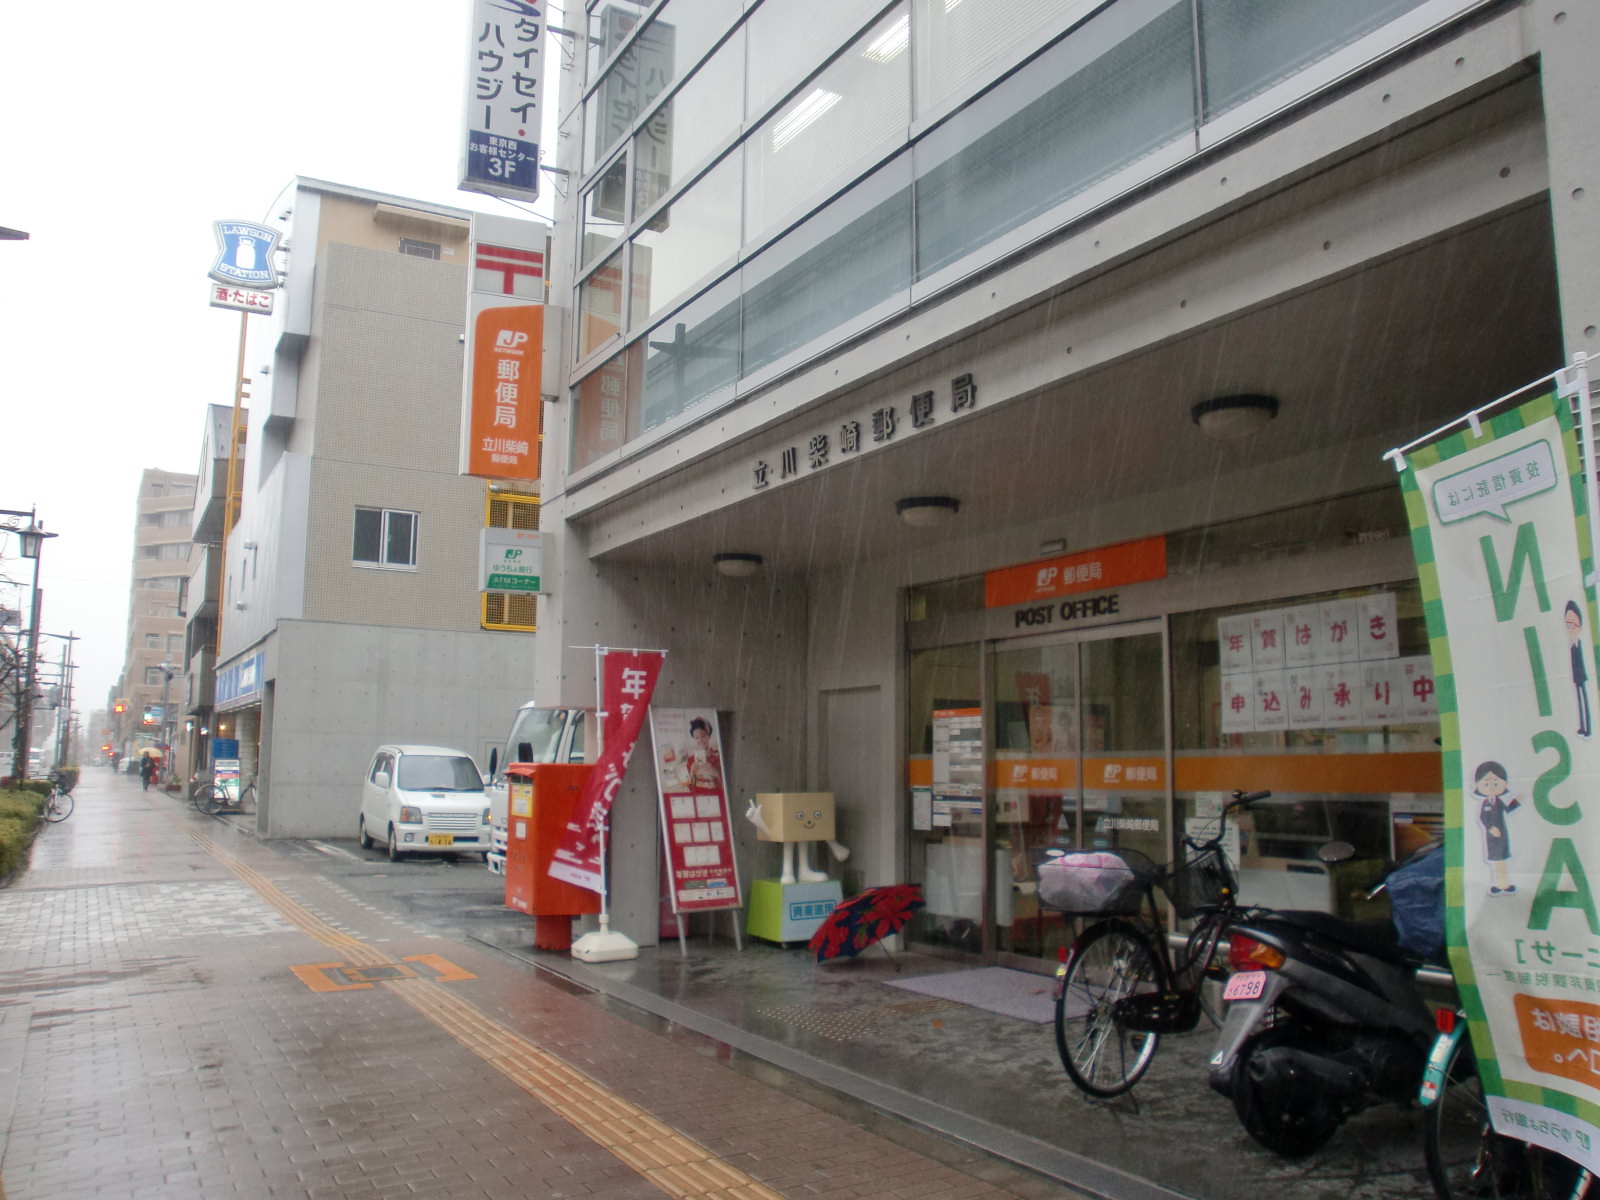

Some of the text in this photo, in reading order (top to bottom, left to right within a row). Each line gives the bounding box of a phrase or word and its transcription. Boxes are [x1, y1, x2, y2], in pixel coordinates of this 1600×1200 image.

[476, 22, 504, 130] ハウジー
[469, 142, 536, 161] お客様センター
[489, 136, 517, 150] 東京西
[488, 158, 516, 178] 3F
[223, 226, 273, 242] LAWSON
[220, 263, 269, 279] STATION
[493, 359, 519, 429] 郵便局
[753, 373, 977, 489] 立川柴崎郵便局
[482, 437, 528, 456] 立川柴崎
[491, 454, 518, 465] 郵便局
[493, 564, 532, 574] ゆうちょ銀行
[1063, 562, 1102, 584] 郵便局
[1015, 594, 1120, 628] POST OFFICE
[1229, 615, 1386, 653] 年賀はがき
[1231, 675, 1434, 713] 申込み承り中
